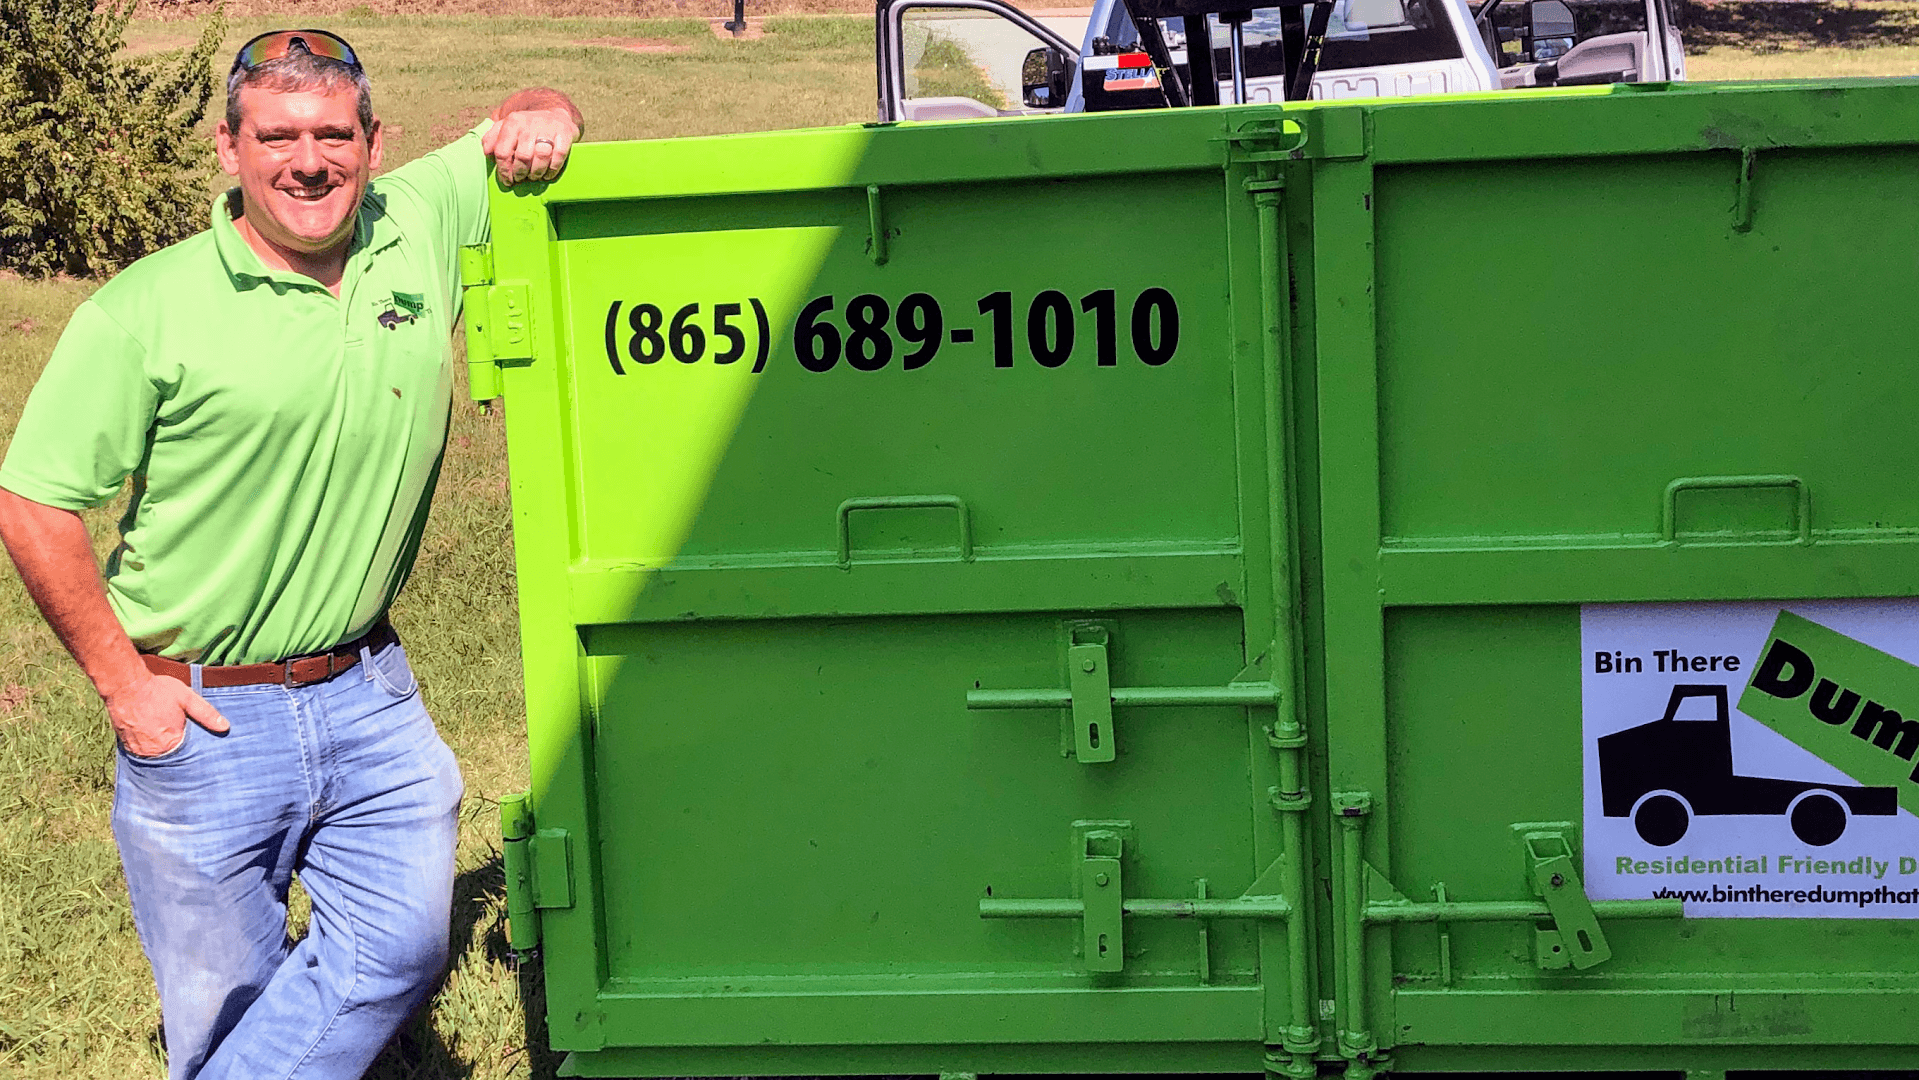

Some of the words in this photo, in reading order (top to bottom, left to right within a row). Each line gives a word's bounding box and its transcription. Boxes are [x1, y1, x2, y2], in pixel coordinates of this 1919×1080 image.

[605, 299, 769, 375] (865)
[794, 287, 1179, 373] 689-1010
[1595, 651, 1642, 673] Bin
[1653, 650, 1740, 672] There
[1751, 639, 1919, 784] Dum
[1616, 857, 1767, 874] Residential
[1778, 856, 1888, 879] Friendly
